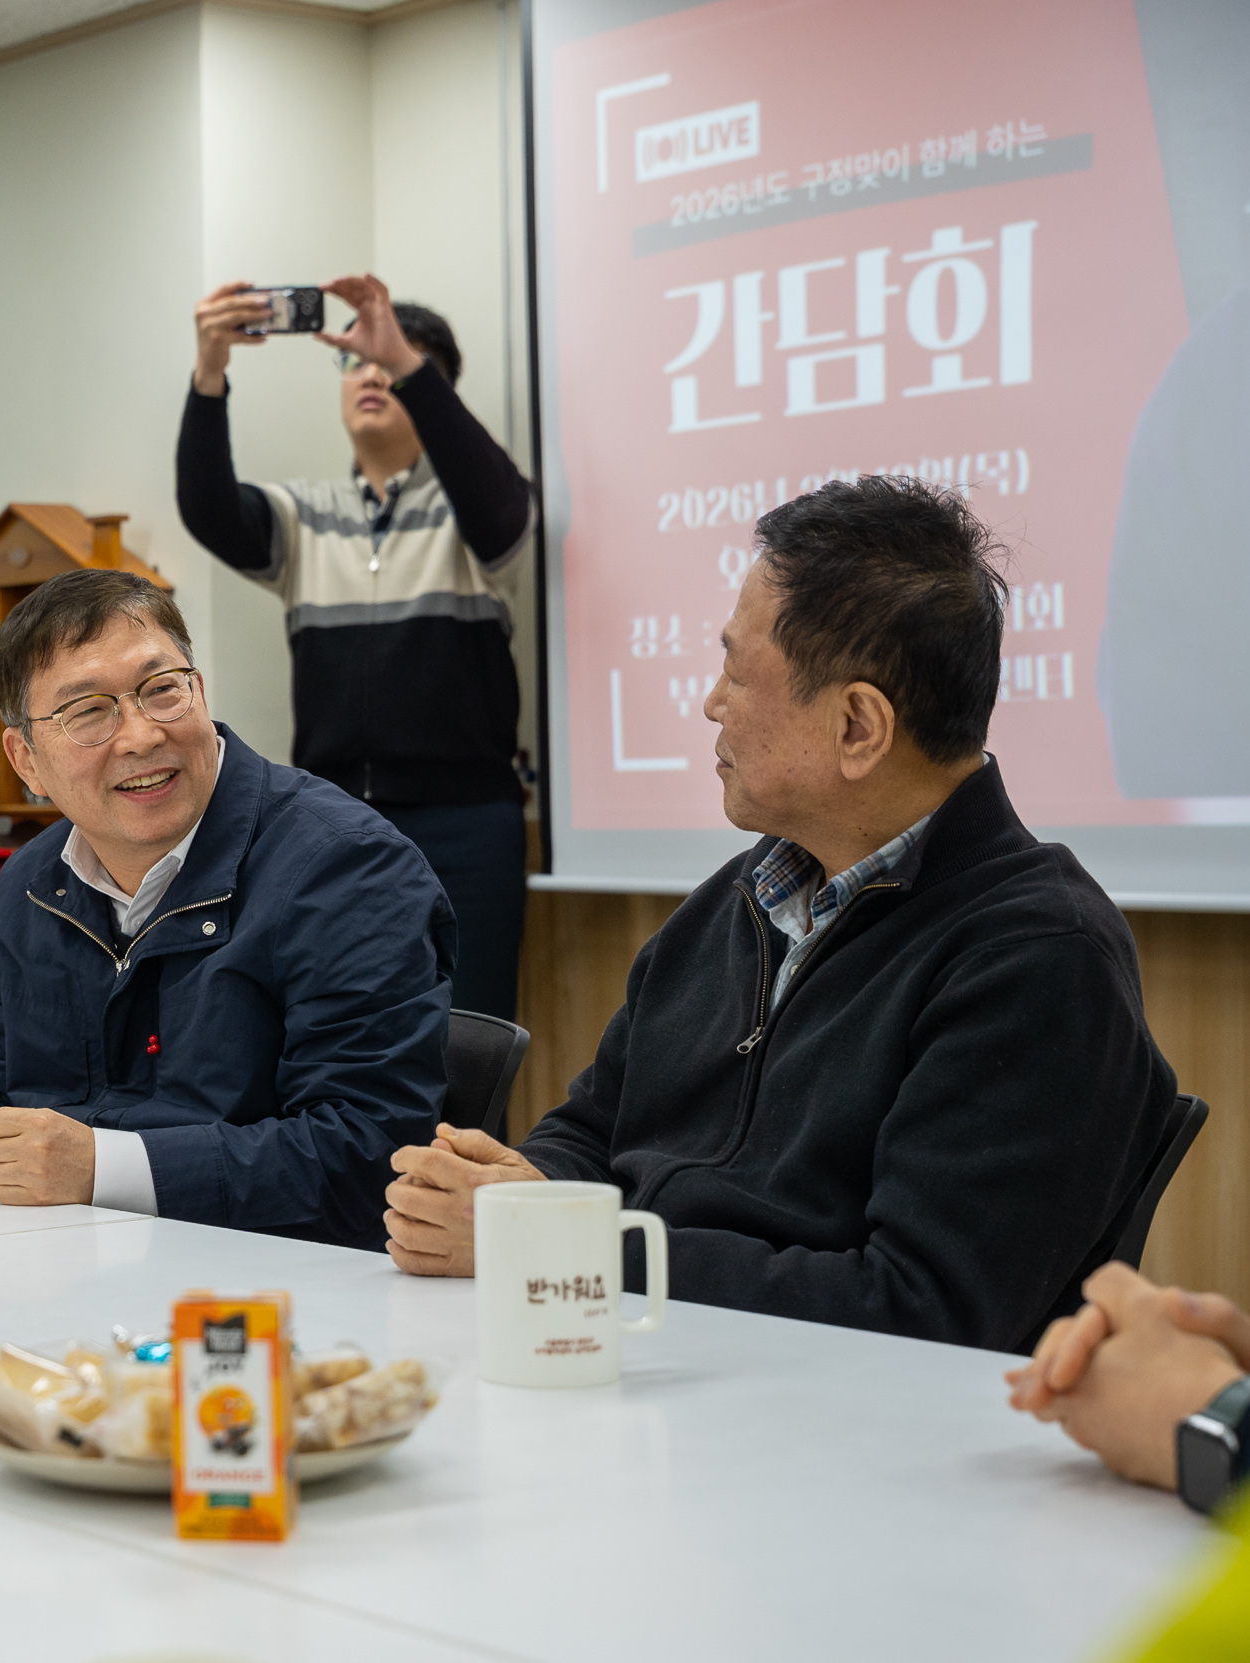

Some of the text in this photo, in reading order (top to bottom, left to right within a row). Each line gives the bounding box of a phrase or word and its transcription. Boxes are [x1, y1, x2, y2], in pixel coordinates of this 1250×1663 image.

[693, 116, 751, 157] LIVE
[670, 119, 1047, 227] 2026년도 구정맞이 함께 하는
[663, 219, 1038, 433] 간담회
[629, 614, 690, 659] 장소
[527, 1274, 605, 1304] 반가워요
